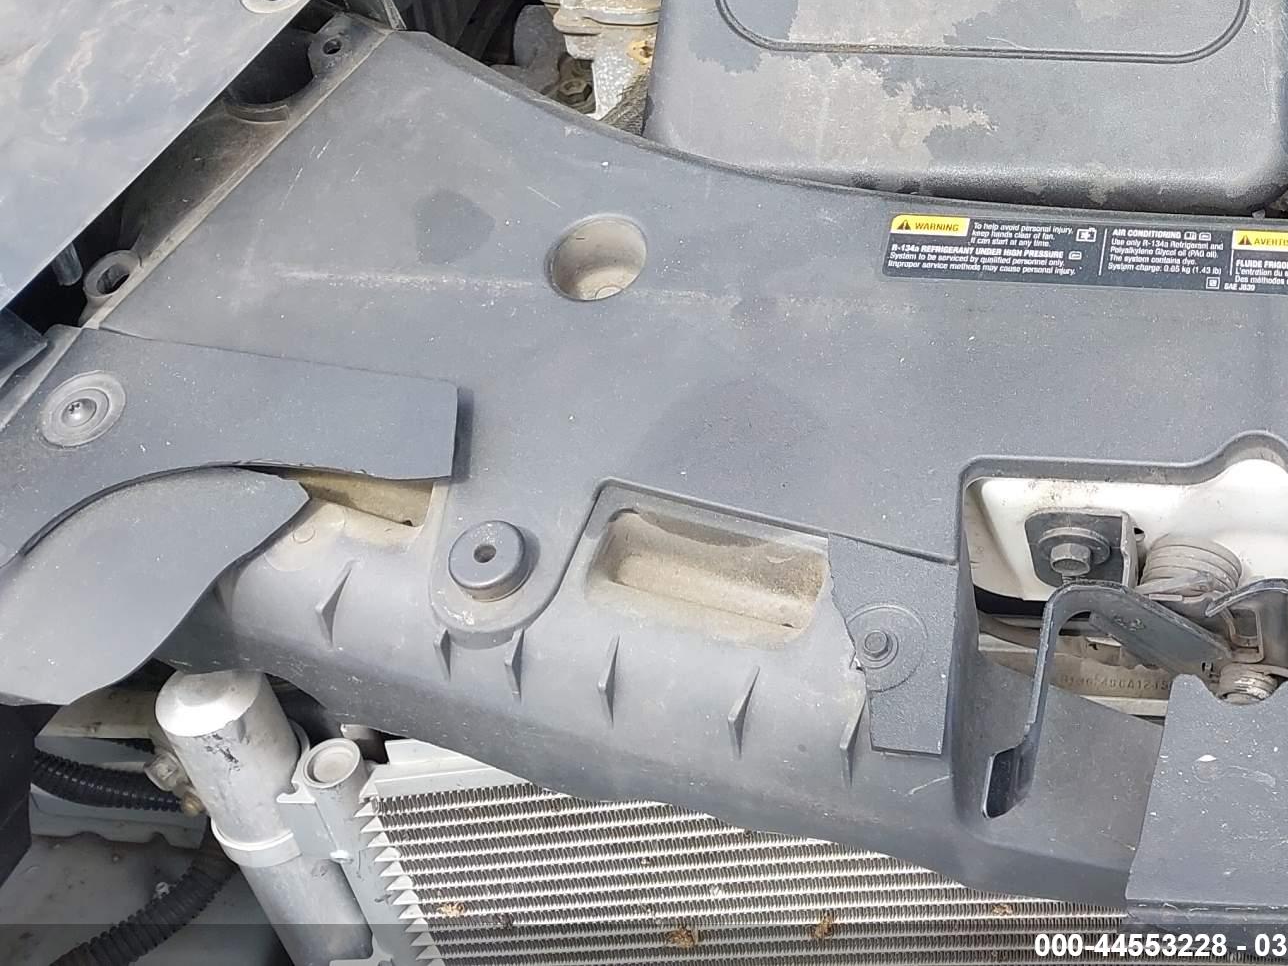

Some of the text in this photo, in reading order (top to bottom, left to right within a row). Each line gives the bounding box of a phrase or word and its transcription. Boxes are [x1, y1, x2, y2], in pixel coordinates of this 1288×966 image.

[915, 222, 959, 232] WARNING
[983, 223, 999, 232] help
[1021, 225, 1051, 233] personal
[1052, 226, 1074, 234] injury.
[971, 230, 990, 238] keep
[1127, 230, 1181, 239] CONDITIONING
[1126, 239, 1141, 248] only
[1142, 240, 1168, 248] R-134a
[1170, 241, 1208, 250] Refrigerant
[892, 244, 1064, 258] R-134a REFRIGERANT UNDER HIGH PRESSURE
[1110, 246, 1154, 255] Polyalkylene
[1155, 248, 1176, 256] Glycol
[890, 252, 916, 260] System
[1048, 259, 1065, 267] only.
[1236, 260, 1262, 268] FLUIDE
[888, 260, 920, 268] Improper
[1054, 268, 1076, 276] injury.
[1108, 262, 1134, 270] System
[1182, 266, 1190, 274] kg
